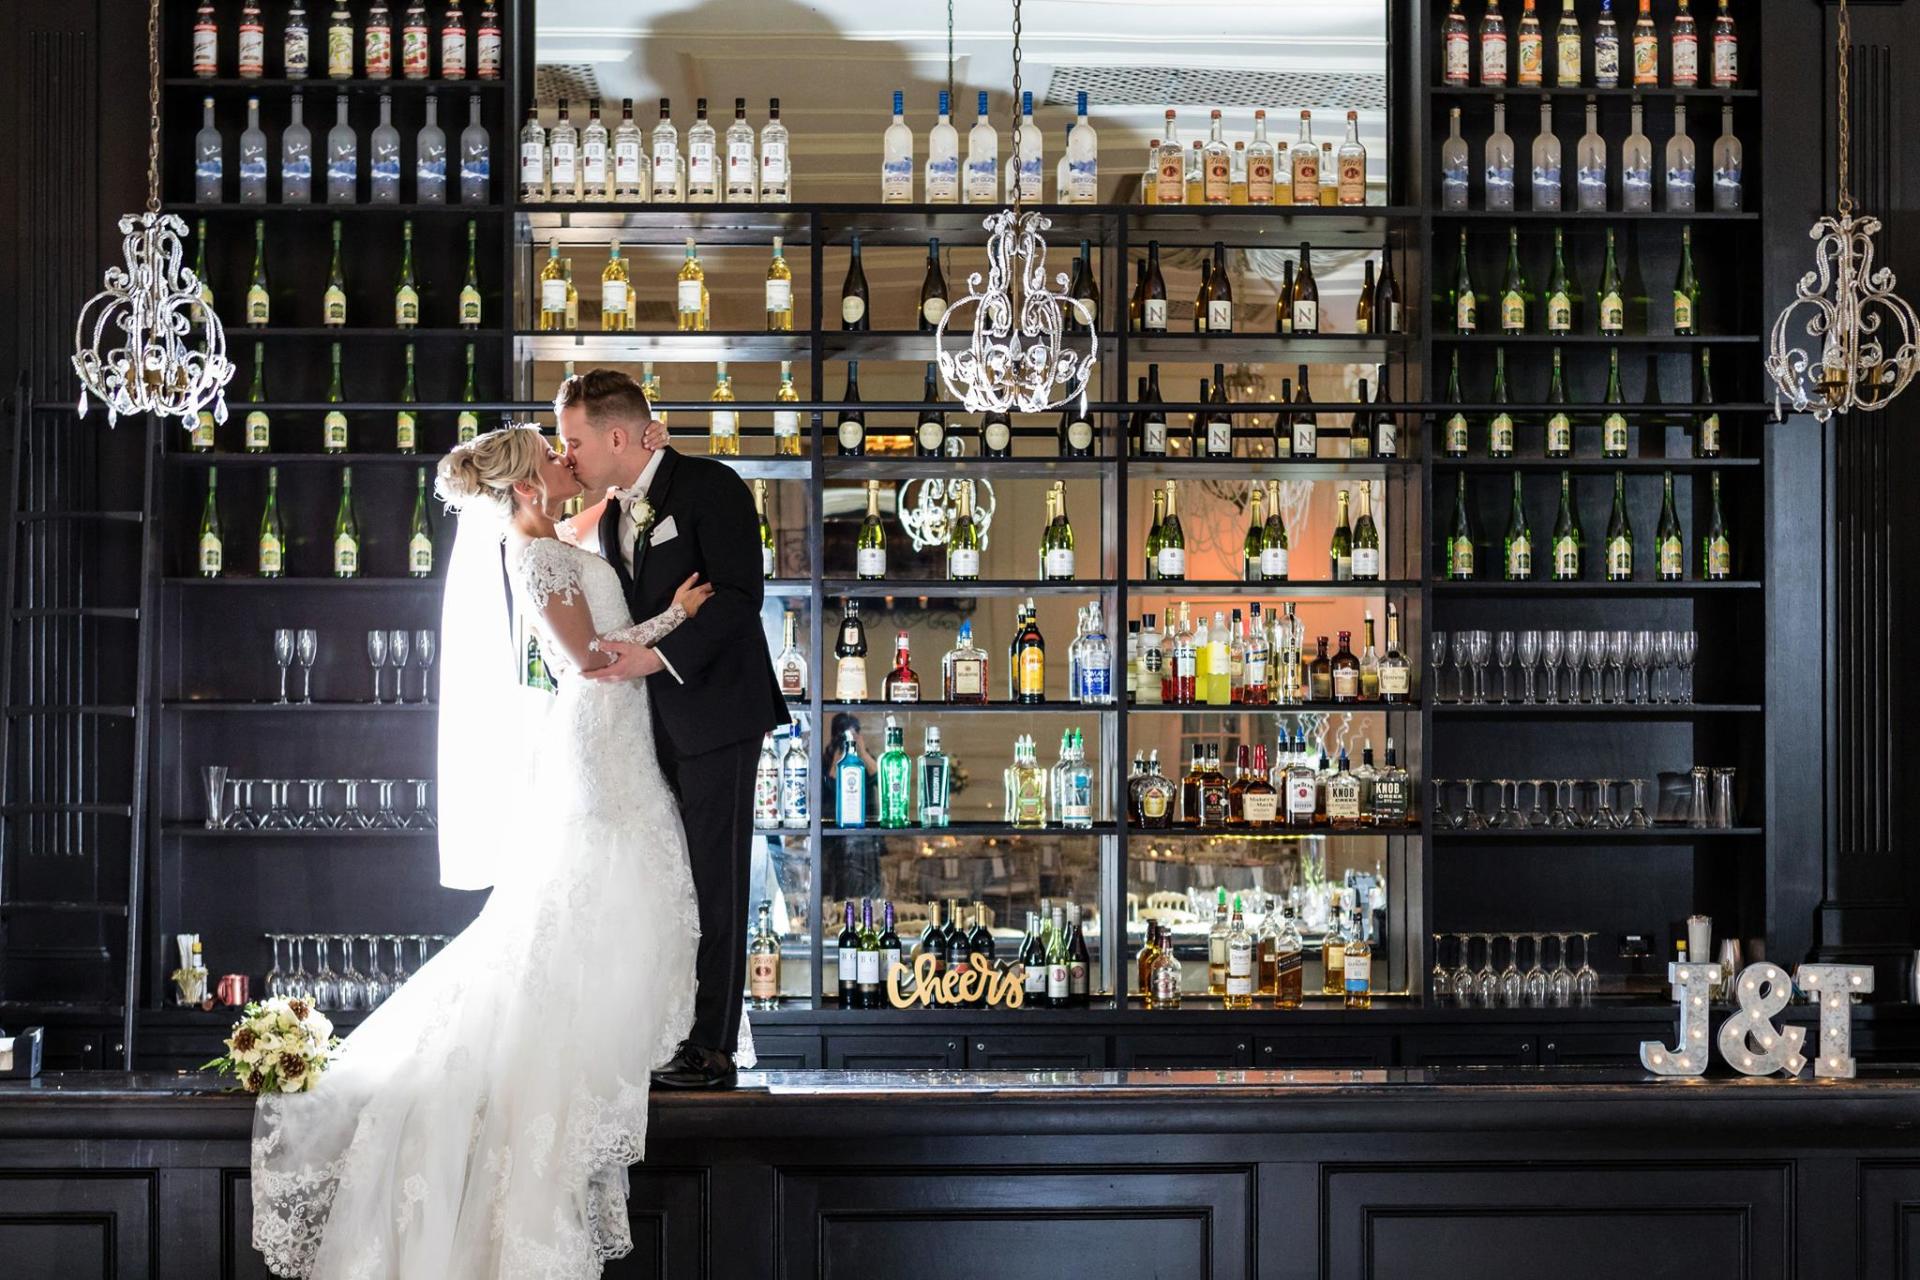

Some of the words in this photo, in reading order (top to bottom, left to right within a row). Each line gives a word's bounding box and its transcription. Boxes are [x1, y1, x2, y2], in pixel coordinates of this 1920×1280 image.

[1150, 306, 1163, 322] N
[1214, 307, 1227, 322] N
[1298, 307, 1312, 323] N
[1149, 430, 1162, 445] N
[1213, 431, 1226, 446] N
[1299, 431, 1312, 446] N
[1332, 787, 1355, 798] KNOB
[1375, 782, 1400, 794] KNOB
[887, 952, 1030, 1009] Cheers
